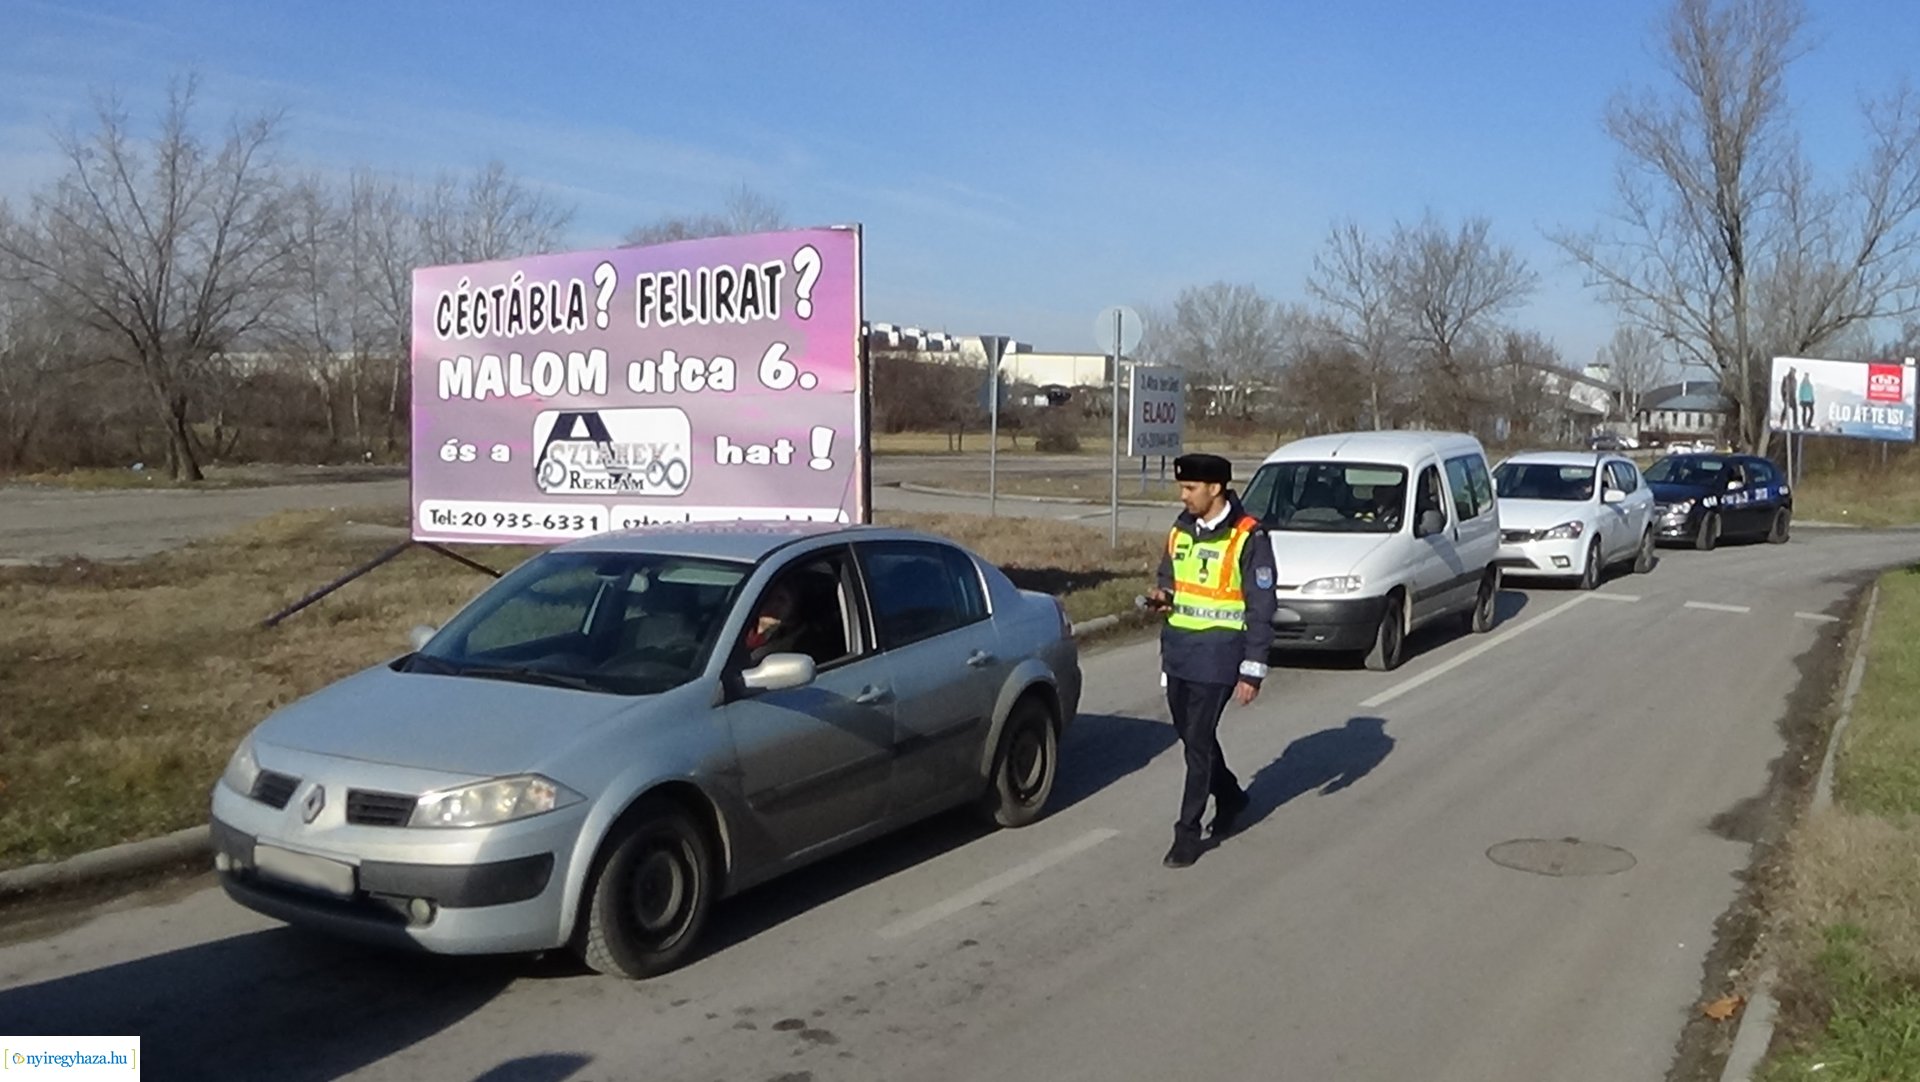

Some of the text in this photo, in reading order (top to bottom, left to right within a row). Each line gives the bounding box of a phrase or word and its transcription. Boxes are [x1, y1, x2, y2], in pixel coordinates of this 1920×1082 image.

[439, 341, 818, 400] MALOM utca 6.
[439, 438, 511, 463] és a
[430, 509, 598, 531] Tel: 20 935-6331
